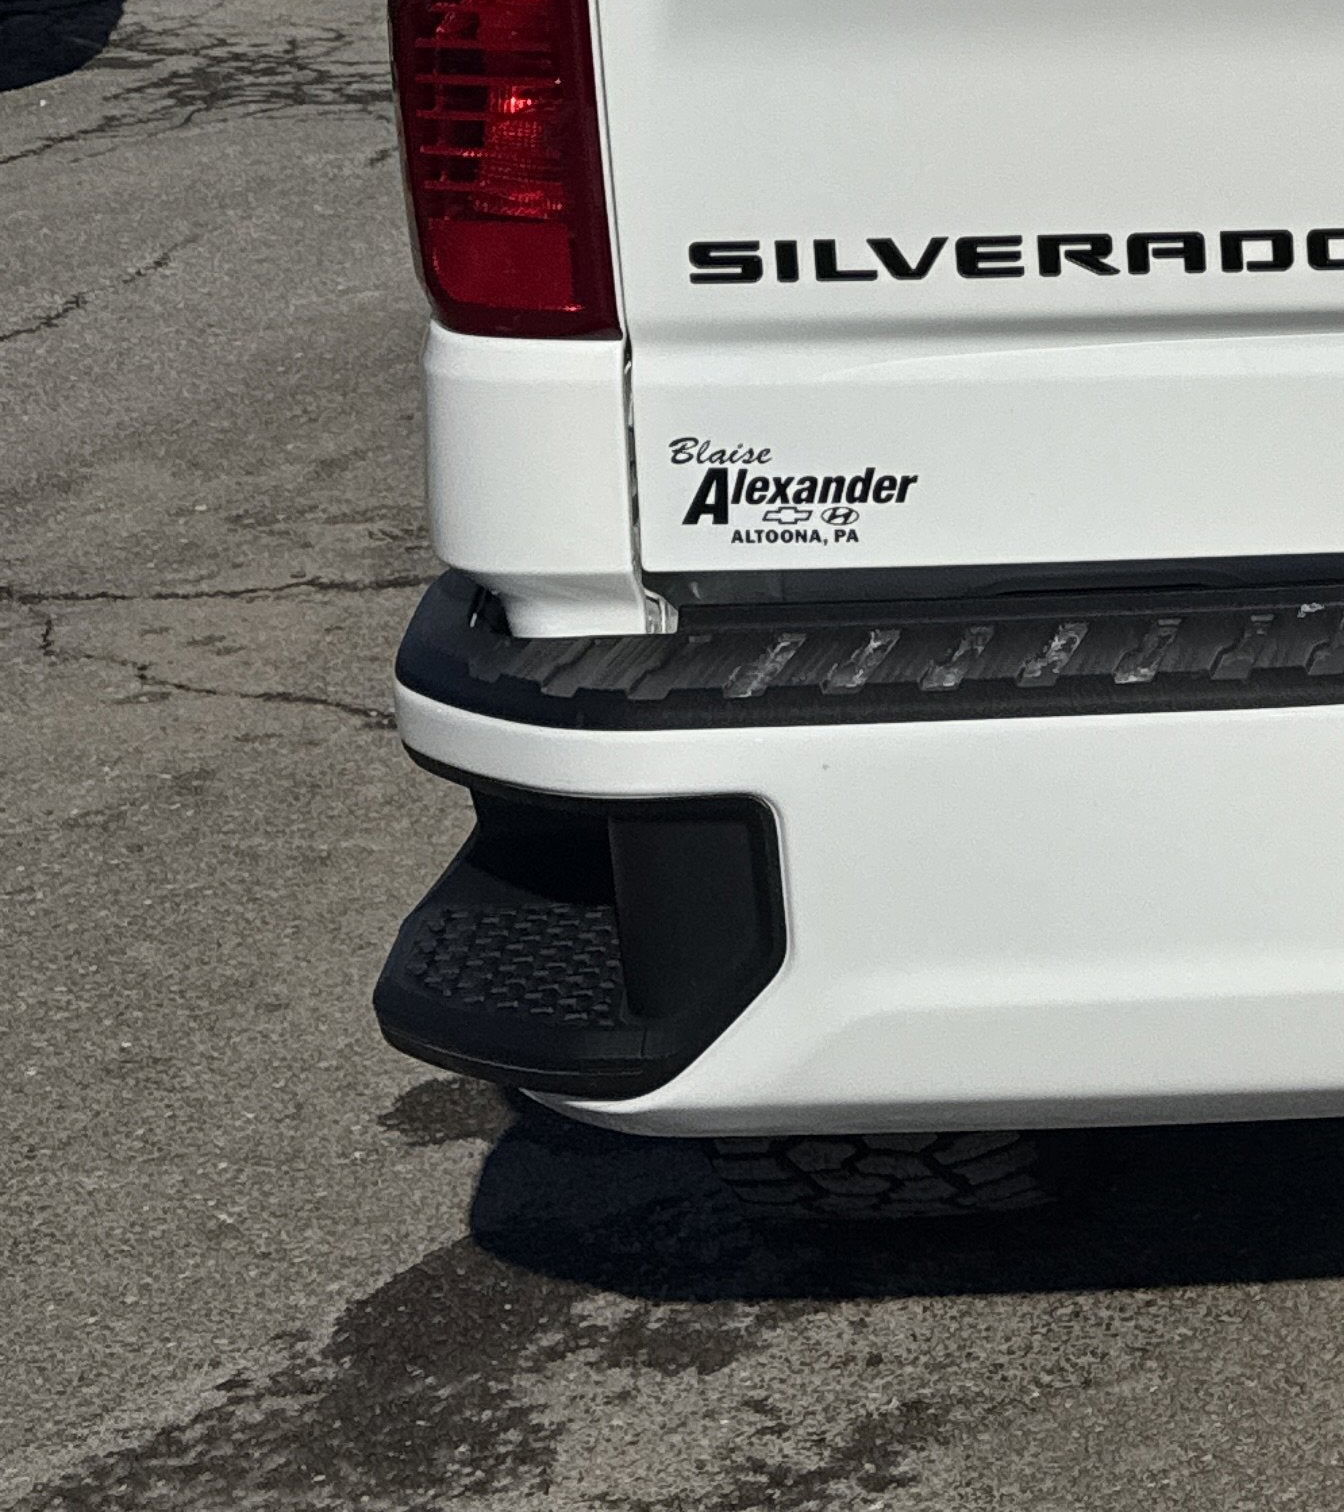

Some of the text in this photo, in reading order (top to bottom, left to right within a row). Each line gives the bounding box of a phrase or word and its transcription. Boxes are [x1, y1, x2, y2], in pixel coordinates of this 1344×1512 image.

[668, 436, 774, 466] Blaise
[682, 467, 919, 526] Alexander
[731, 529, 859, 545] ALTOONA, PA
